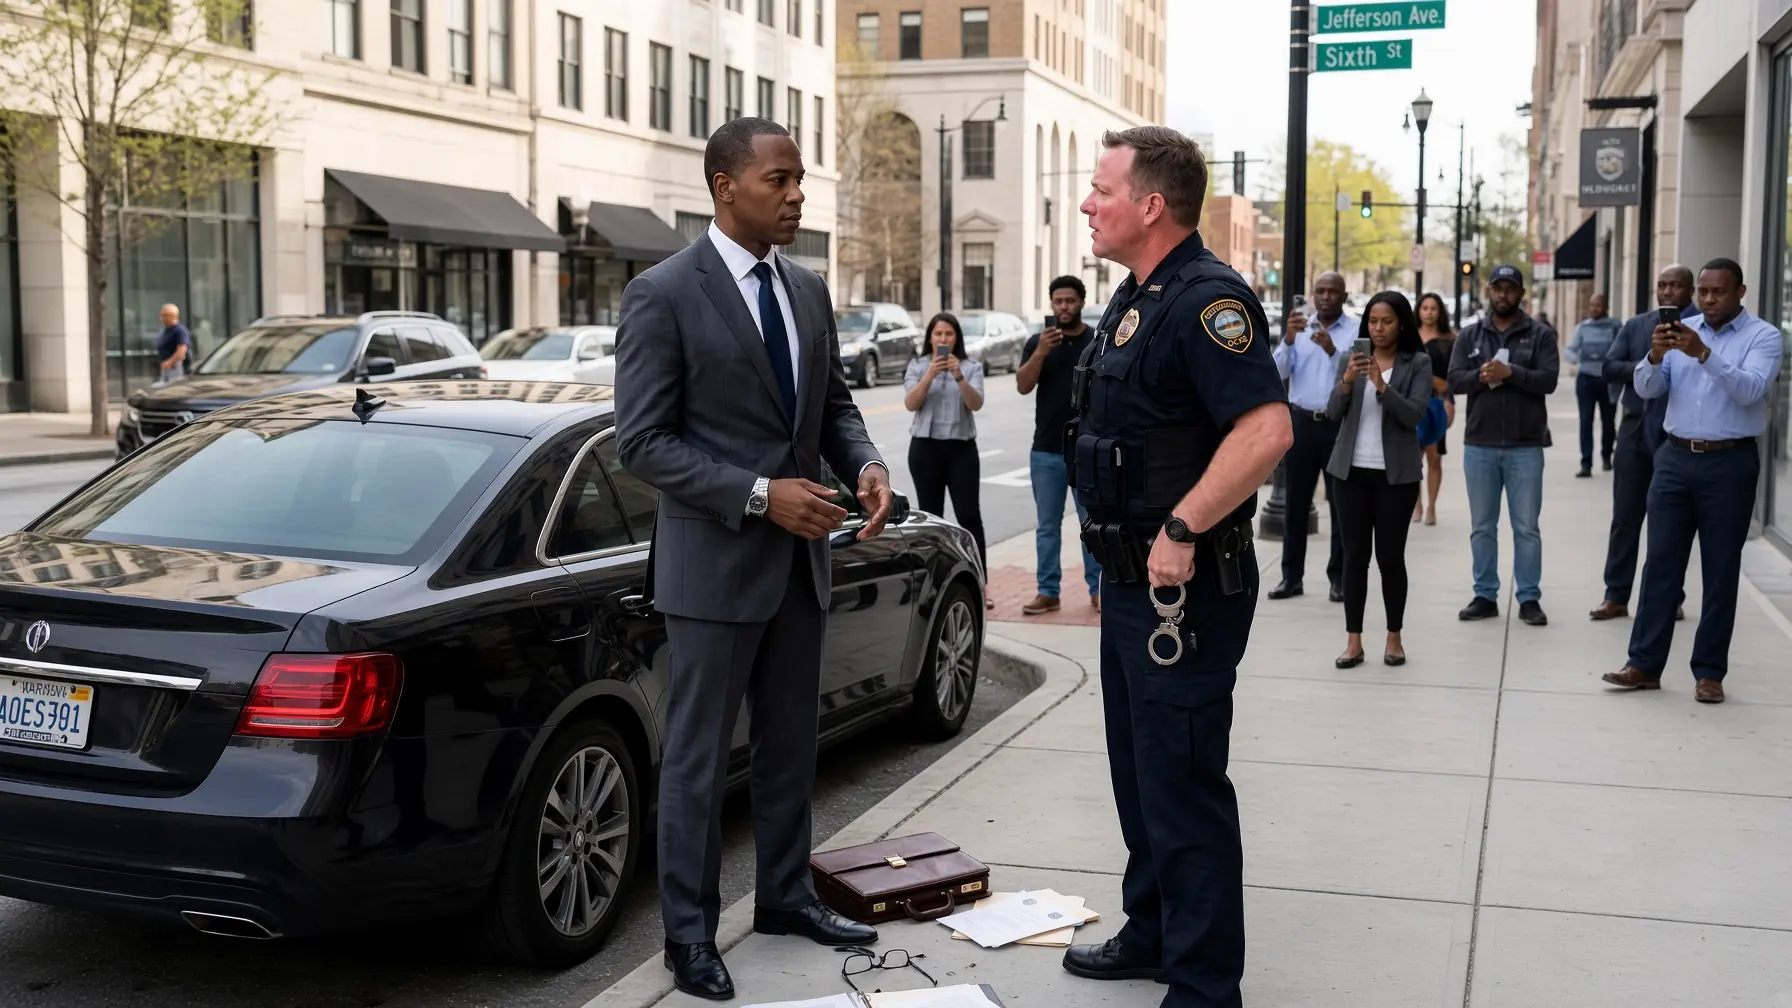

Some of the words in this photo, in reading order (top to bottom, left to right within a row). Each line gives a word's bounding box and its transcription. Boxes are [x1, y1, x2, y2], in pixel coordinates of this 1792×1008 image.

[1323, 8, 1402, 30] Jefferson
[1408, 5, 1443, 25] Ave.
[1325, 46, 1377, 67] Sixth
[1386, 43, 1402, 59] St
